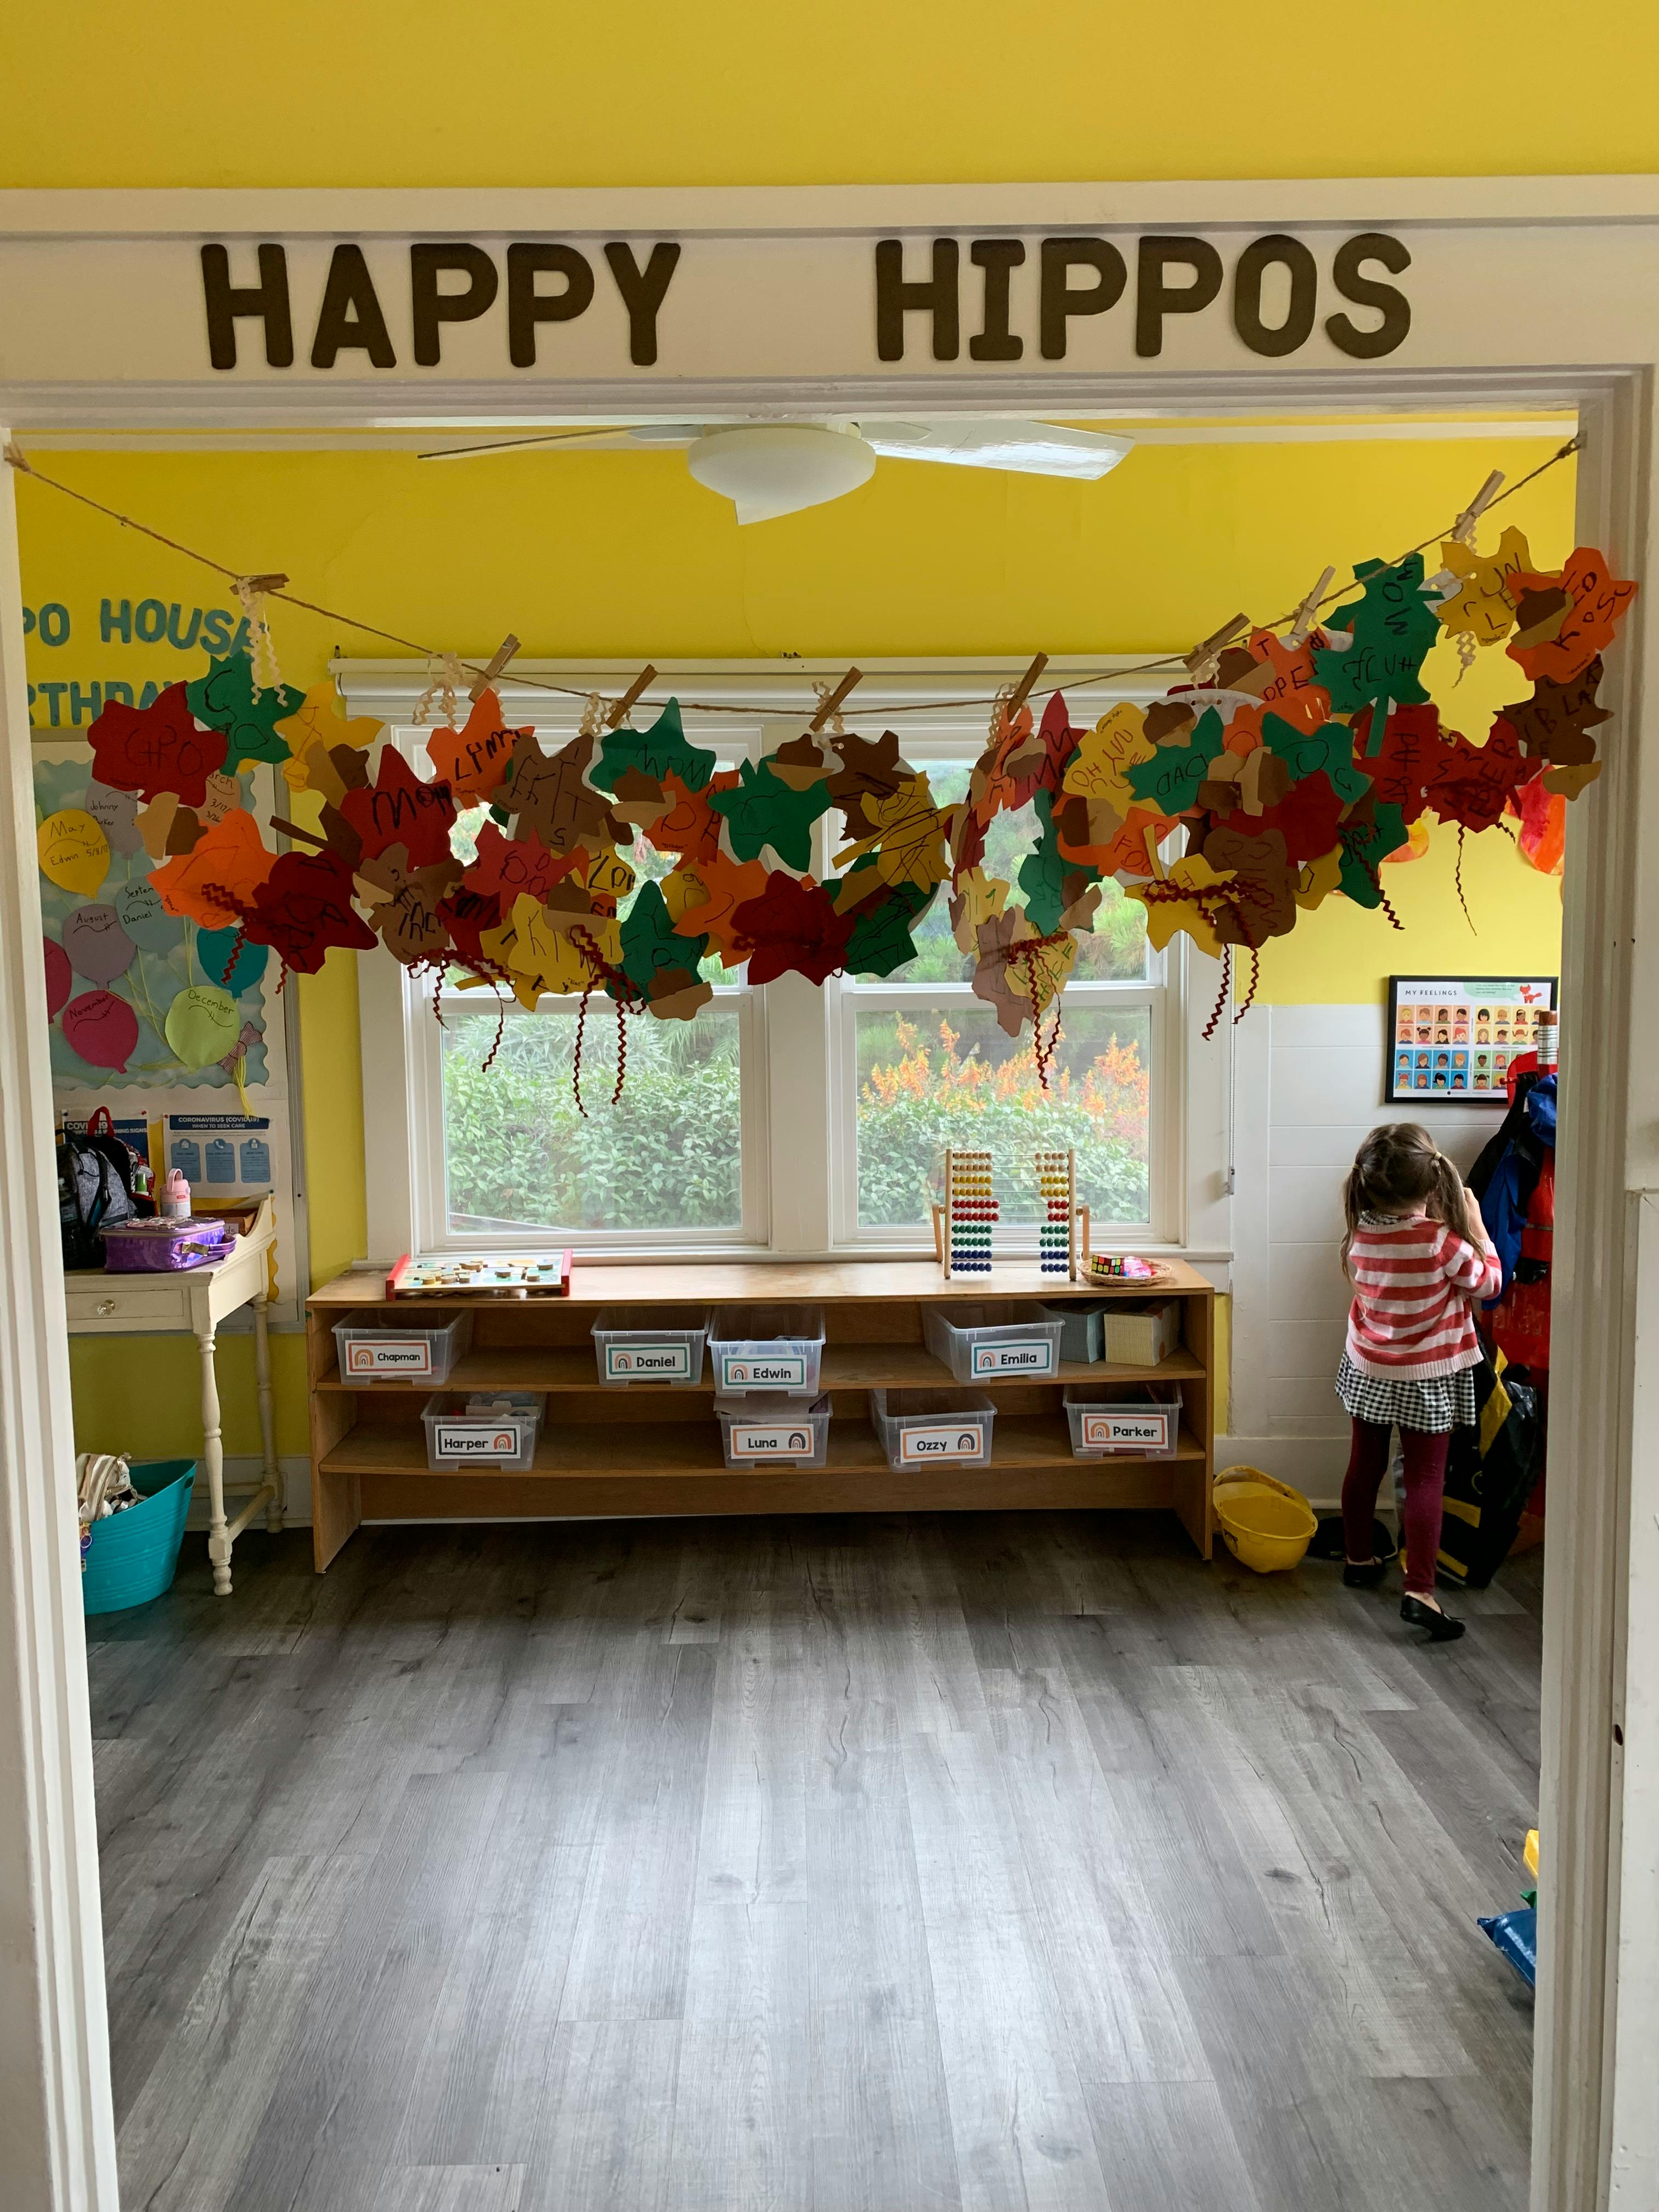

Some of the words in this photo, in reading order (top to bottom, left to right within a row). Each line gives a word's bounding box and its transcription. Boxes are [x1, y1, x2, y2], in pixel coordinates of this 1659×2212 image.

[201, 242, 681, 370] HAPPY
[877, 233, 1412, 361] HIPPOS
[90, 800, 119, 811] Johnny
[50, 820, 85, 838] May
[50, 854, 79, 866] Edwin
[76, 913, 109, 924] August
[122, 911, 152, 924] Daniel
[69, 994, 109, 1020] November
[188, 990, 234, 1014] December
[377, 1352, 420, 1364] Chapman
[636, 1356, 676, 1368] Daniel
[1001, 1352, 1037, 1366] Emilia
[753, 1367, 791, 1380] Edwin
[1113, 1425, 1158, 1438] Parker
[444, 1438, 488, 1451] Harper
[748, 1436, 777, 1449] Luna
[917, 1439, 947, 1453] Ozzy
